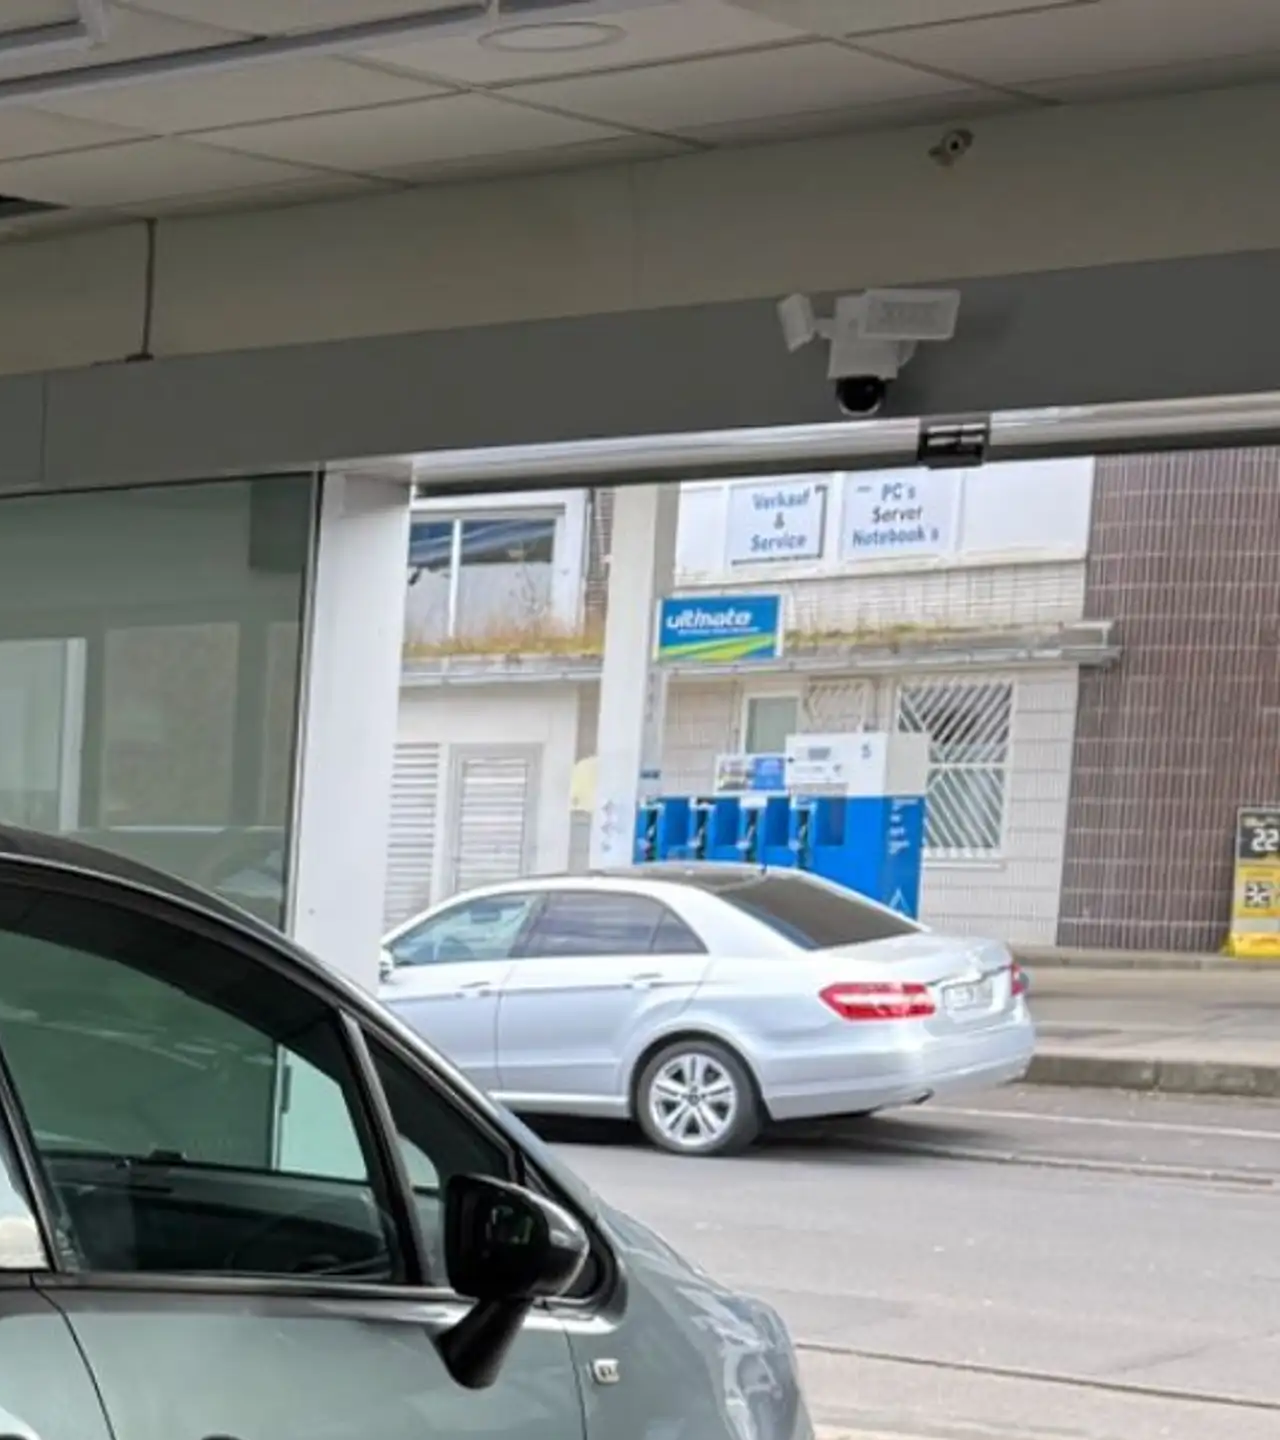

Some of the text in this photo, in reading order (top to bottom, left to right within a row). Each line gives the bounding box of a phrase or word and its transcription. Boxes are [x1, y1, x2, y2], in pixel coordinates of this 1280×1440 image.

[752, 486, 810, 511] Verkauf
[872, 504, 923, 524] Server
[750, 533, 807, 552] Service
[665, 606, 752, 629] ultimate
